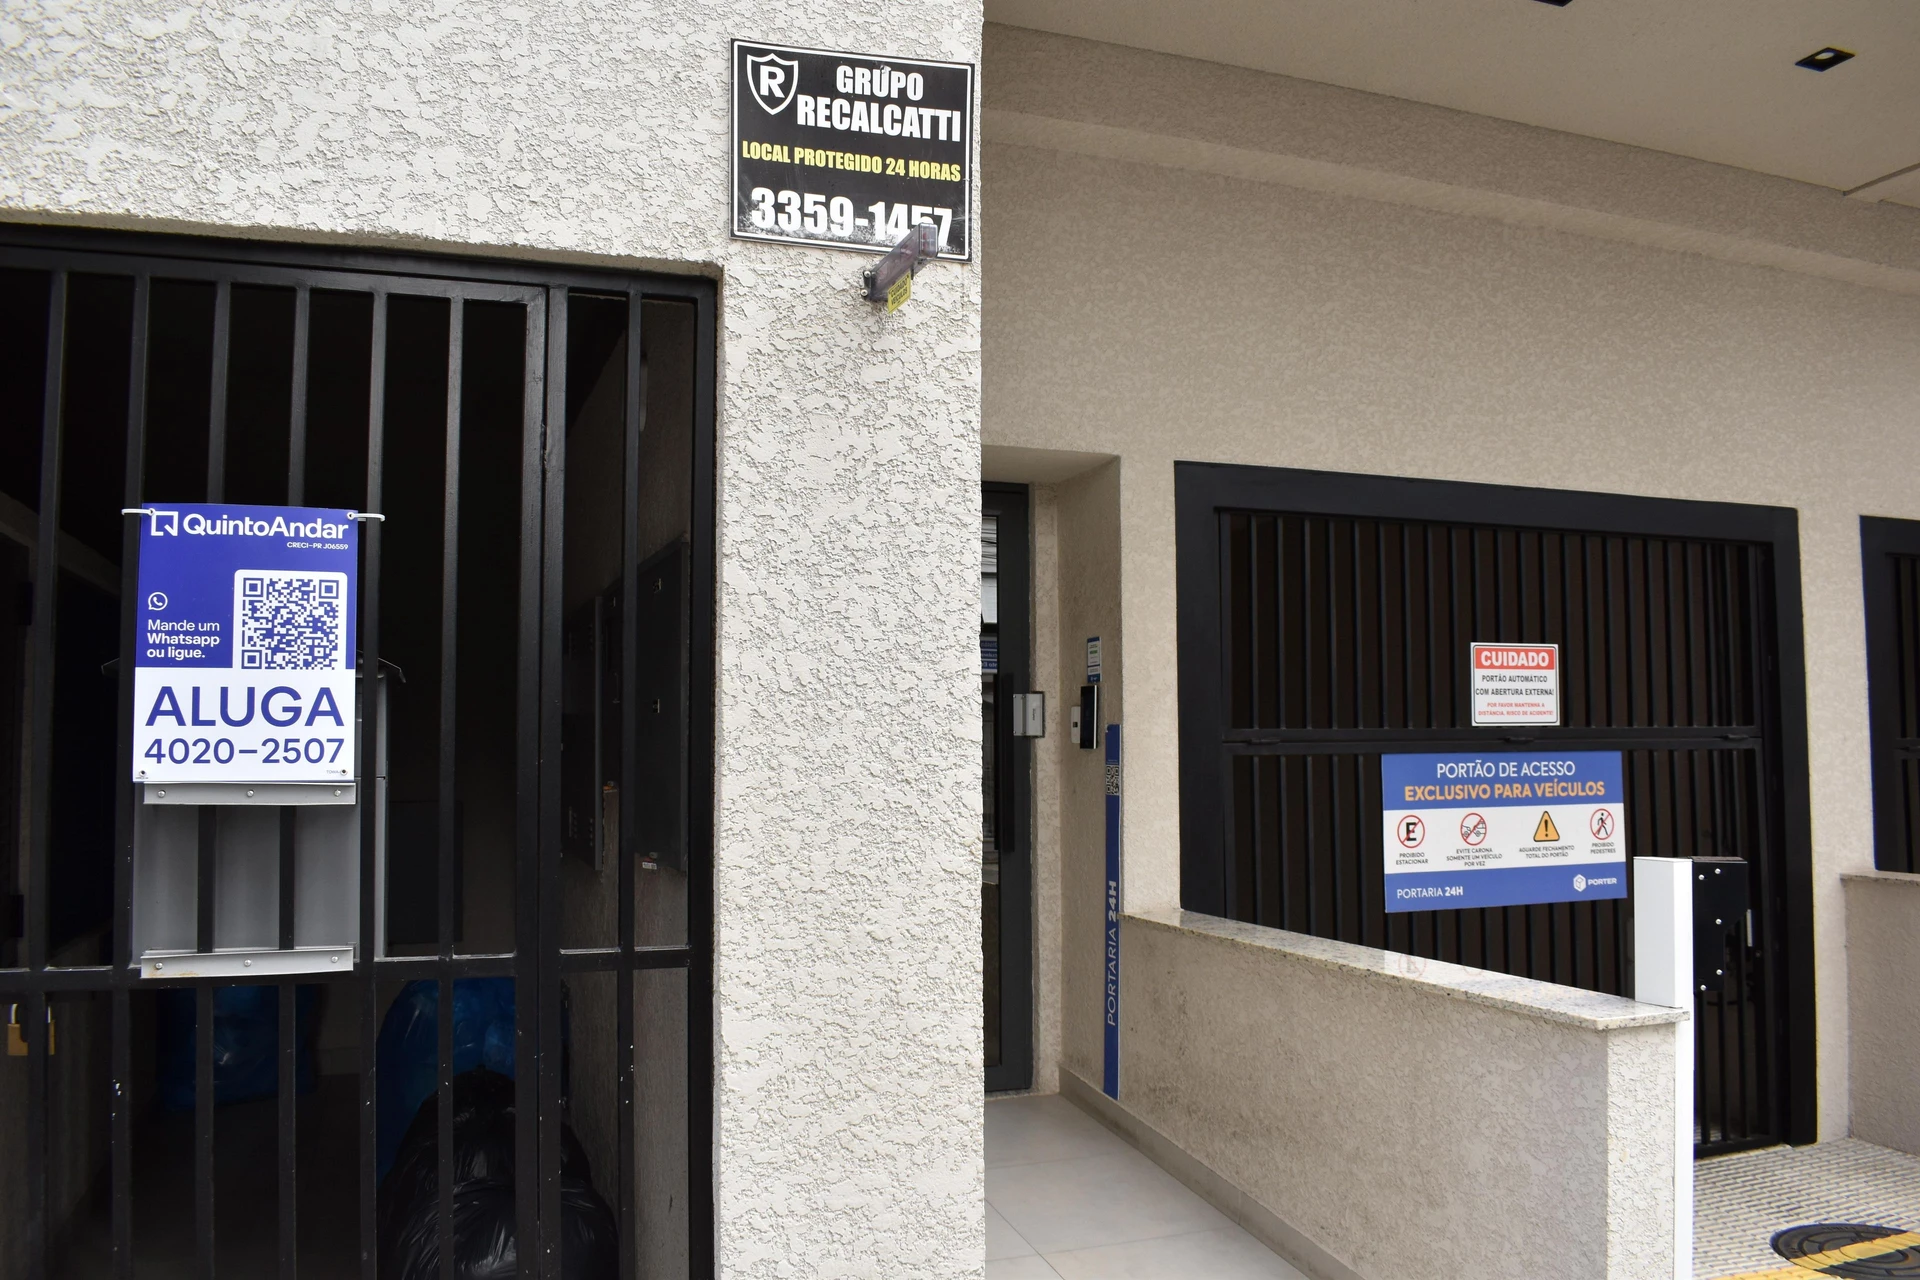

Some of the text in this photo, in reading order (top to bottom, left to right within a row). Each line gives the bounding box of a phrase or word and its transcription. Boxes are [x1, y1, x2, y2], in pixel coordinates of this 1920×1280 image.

[759, 65, 786, 98] R
[836, 65, 924, 101] GRUPO
[797, 94, 961, 142] RECALCATTI
[742, 141, 961, 182] LOCAL PROTEGIDO 24 HORAS
[182, 513, 349, 539] QuintoAndar
[147, 619, 220, 632] Mande um
[147, 632, 220, 648] Whatsapp
[146, 647, 206, 661] ou ligue.
[1480, 650, 1550, 667] CUIDADO
[1481, 673, 1548, 683] PORTÃO AUTOMÁTICO
[1475, 688, 1490, 696] COM
[1491, 688, 1524, 696] ABERTURA
[145, 686, 345, 727] ALUGA
[144, 738, 345, 765] 4020-2507
[1436, 759, 1576, 779] PORTÃO DE ACESSO
[1404, 778, 1606, 802] EXCLUSIVO PARA VEÍCULOS
[1395, 858, 1429, 866] ESTACIONAR
[1587, 878, 1618, 886] PORTER
[1397, 886, 1464, 899] PORTARIA 24H
[1107, 880, 1117, 1026] PORTARIA 24H
